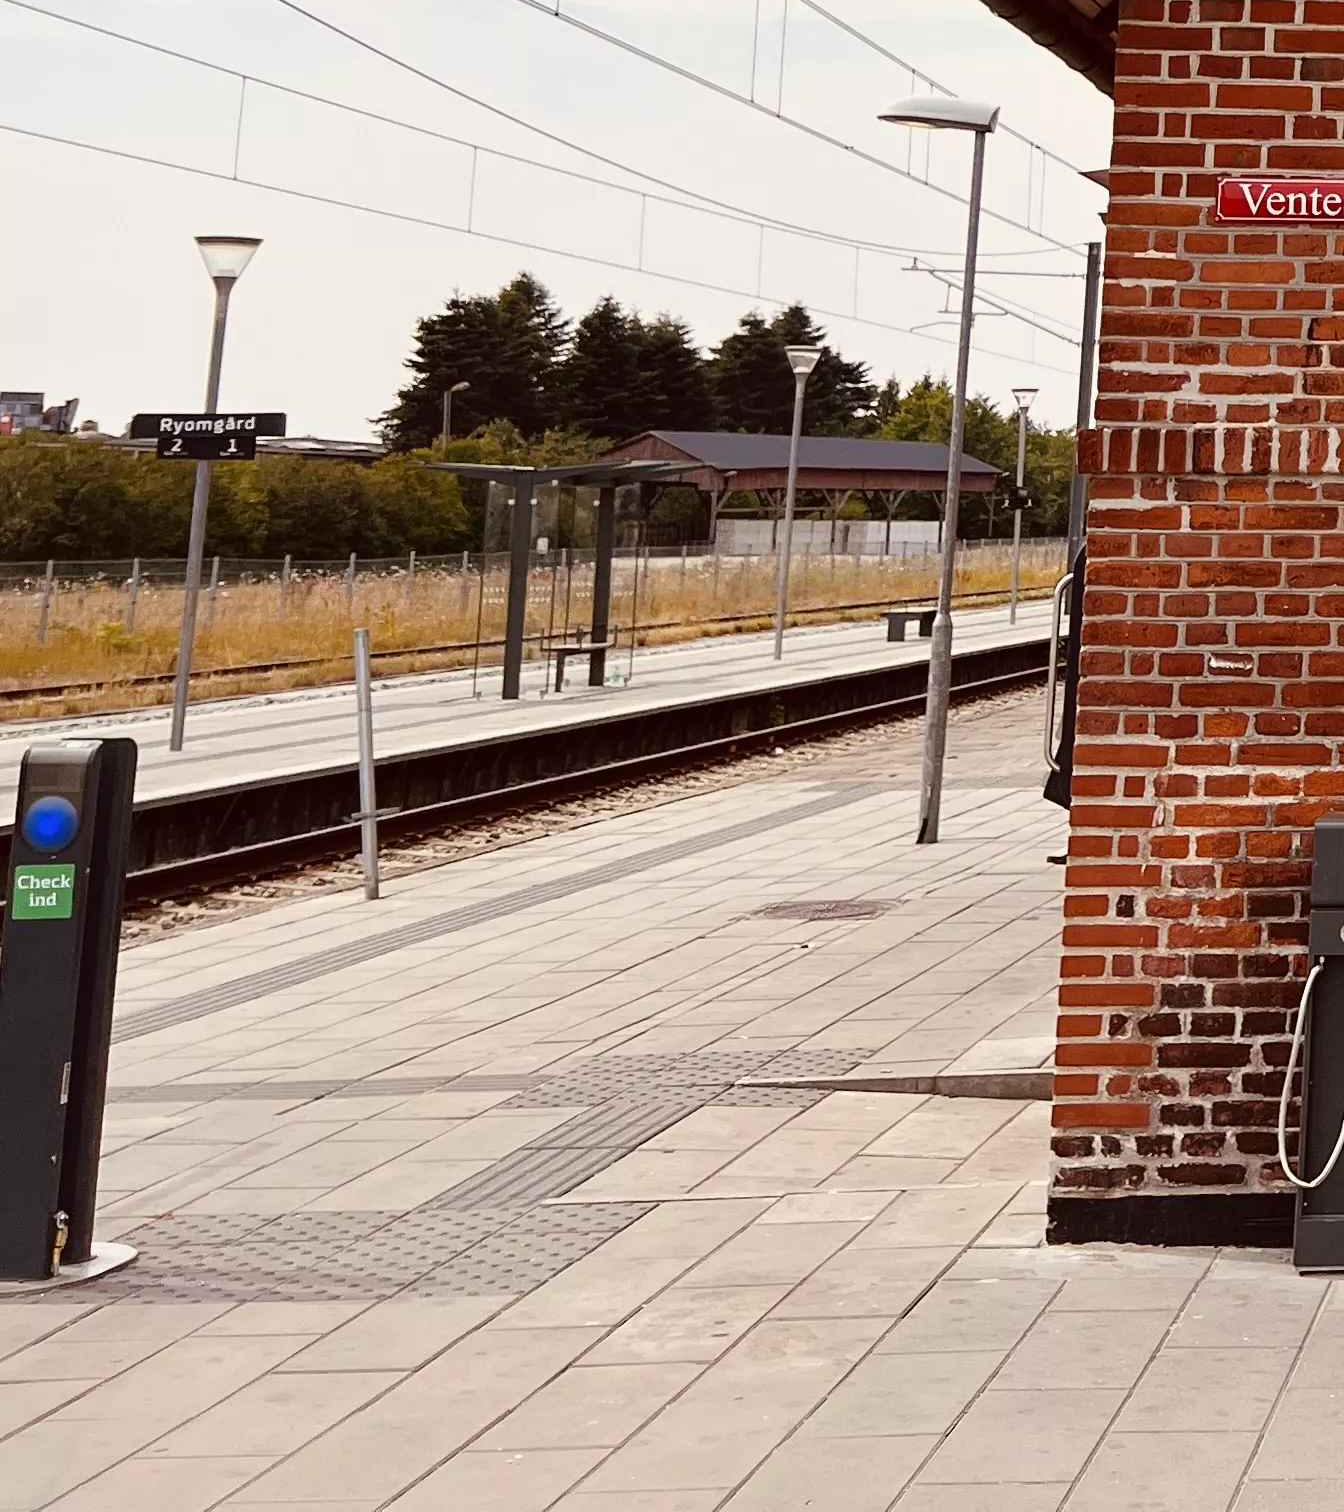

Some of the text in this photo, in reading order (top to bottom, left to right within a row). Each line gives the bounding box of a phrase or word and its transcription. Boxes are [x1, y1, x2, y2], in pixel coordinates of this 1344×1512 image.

[159, 416, 256, 435] Ryomgård
[170, 438, 238, 452] 2 1
[17, 874, 71, 889] Check
[29, 892, 57, 907] ind
